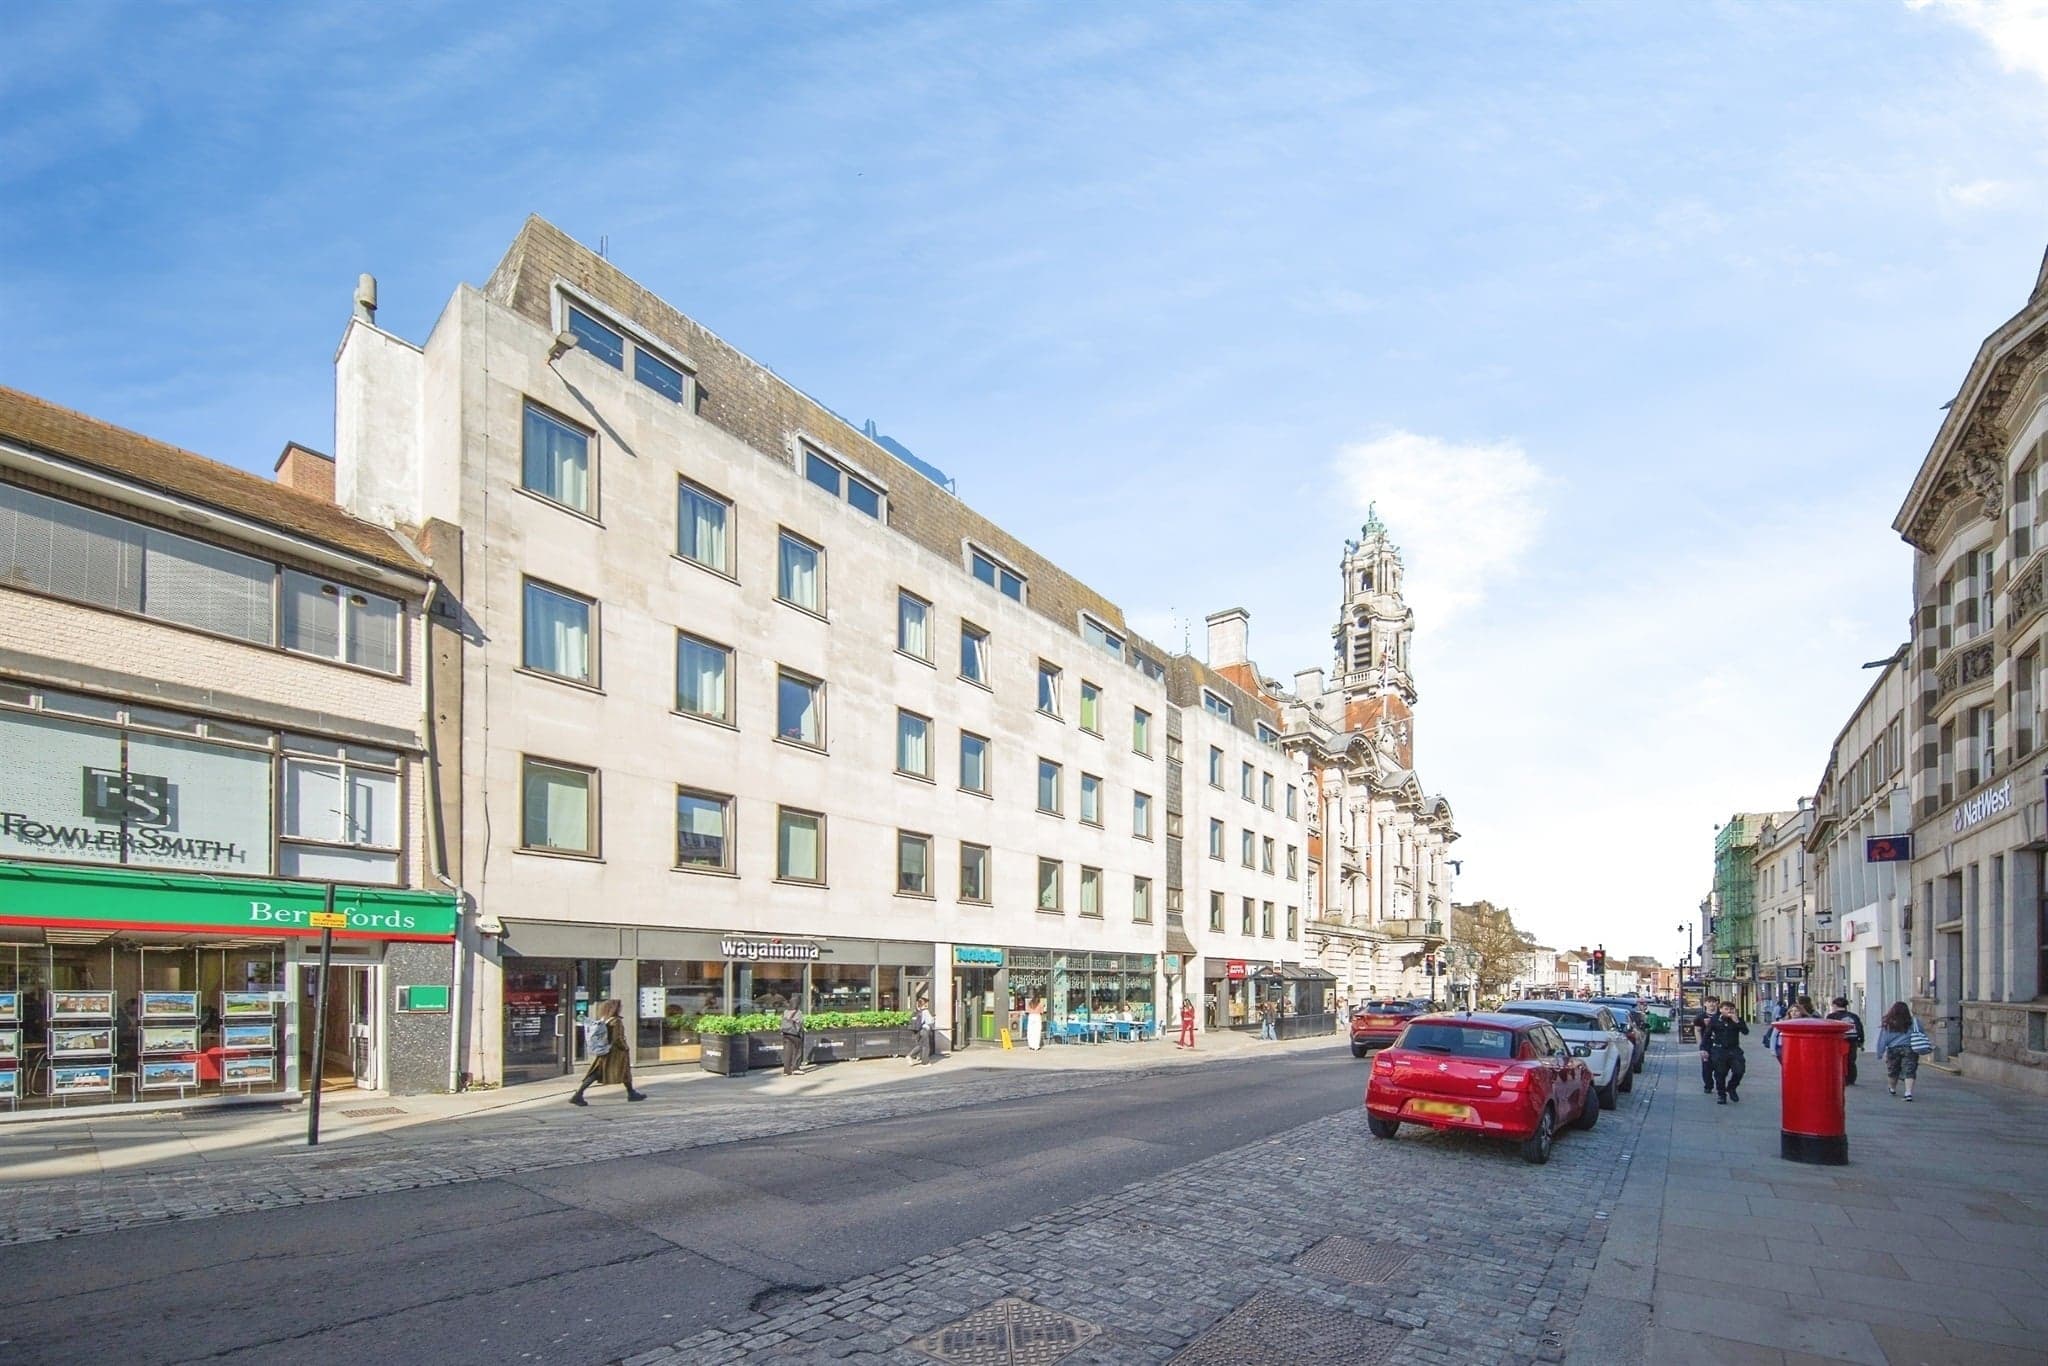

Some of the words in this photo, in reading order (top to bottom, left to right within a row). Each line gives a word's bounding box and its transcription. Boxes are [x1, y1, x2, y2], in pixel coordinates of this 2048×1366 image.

[1963, 779, 2010, 829] NatWest
[250, 901, 416, 929] Berfords
[721, 940, 819, 960] wagamama
